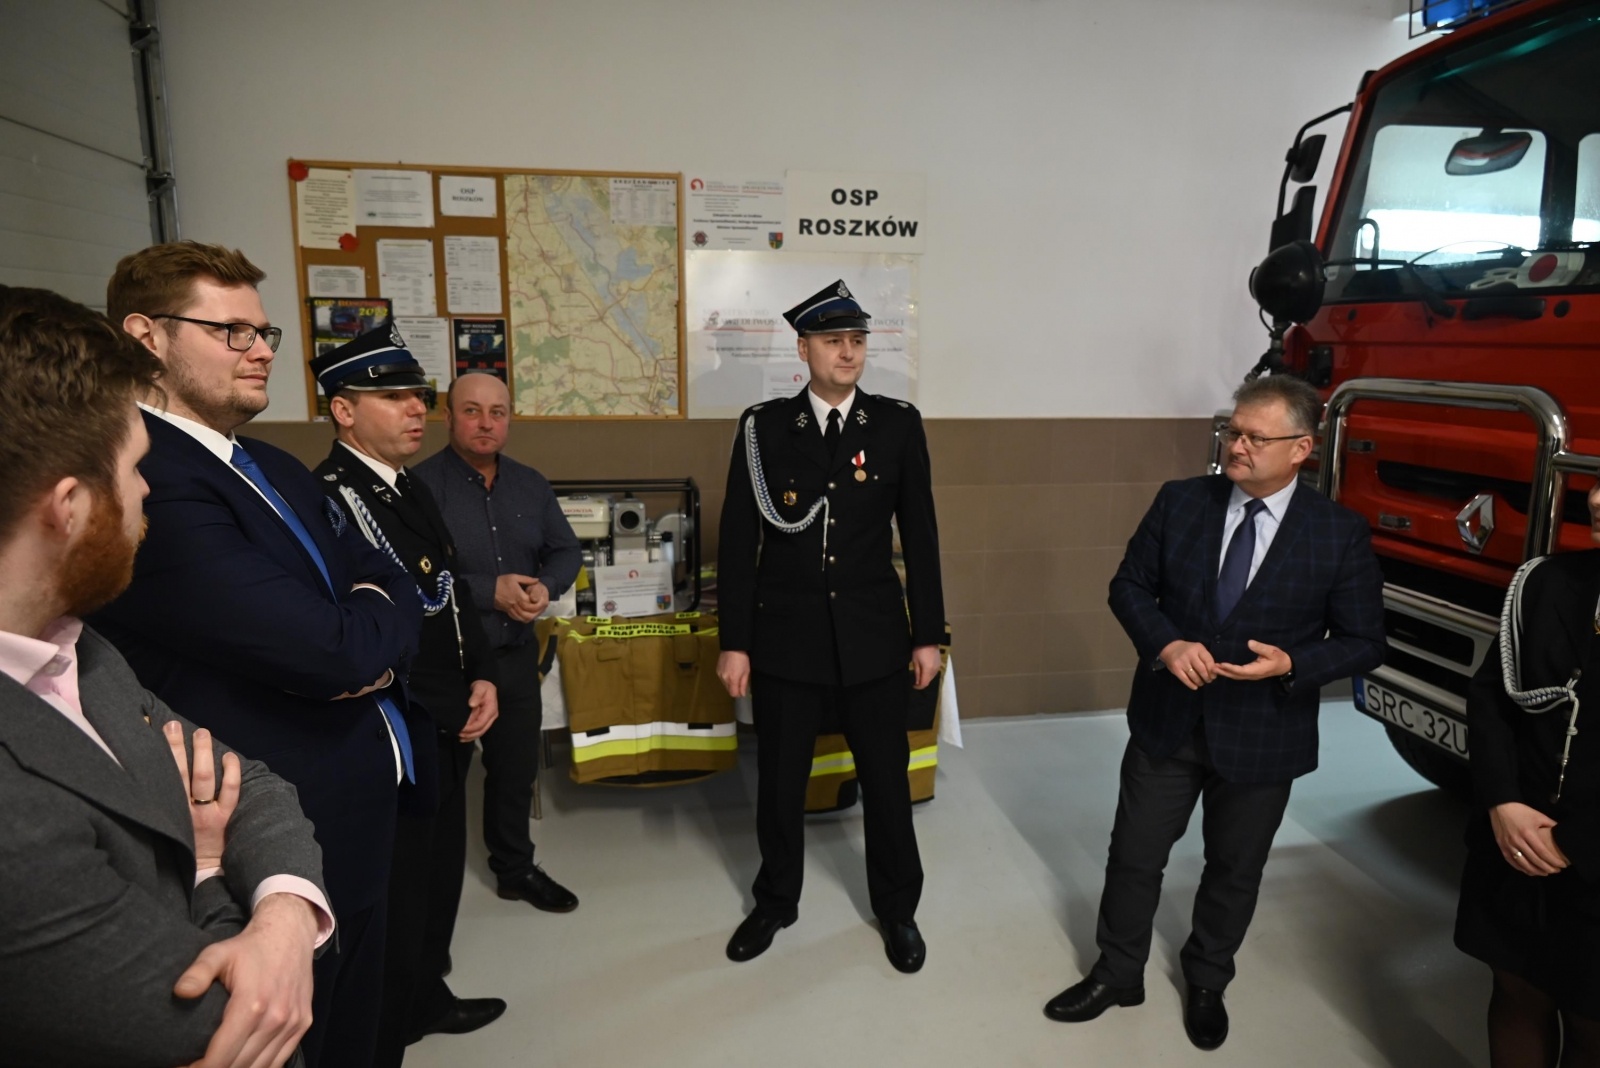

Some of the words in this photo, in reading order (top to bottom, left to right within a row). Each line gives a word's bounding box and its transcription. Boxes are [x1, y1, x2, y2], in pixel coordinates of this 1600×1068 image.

[831, 188, 879, 206] OSP
[799, 216, 919, 237] ROSZKÓW
[1366, 683, 1414, 729] SRC
[1422, 710, 1469, 755] 32U
